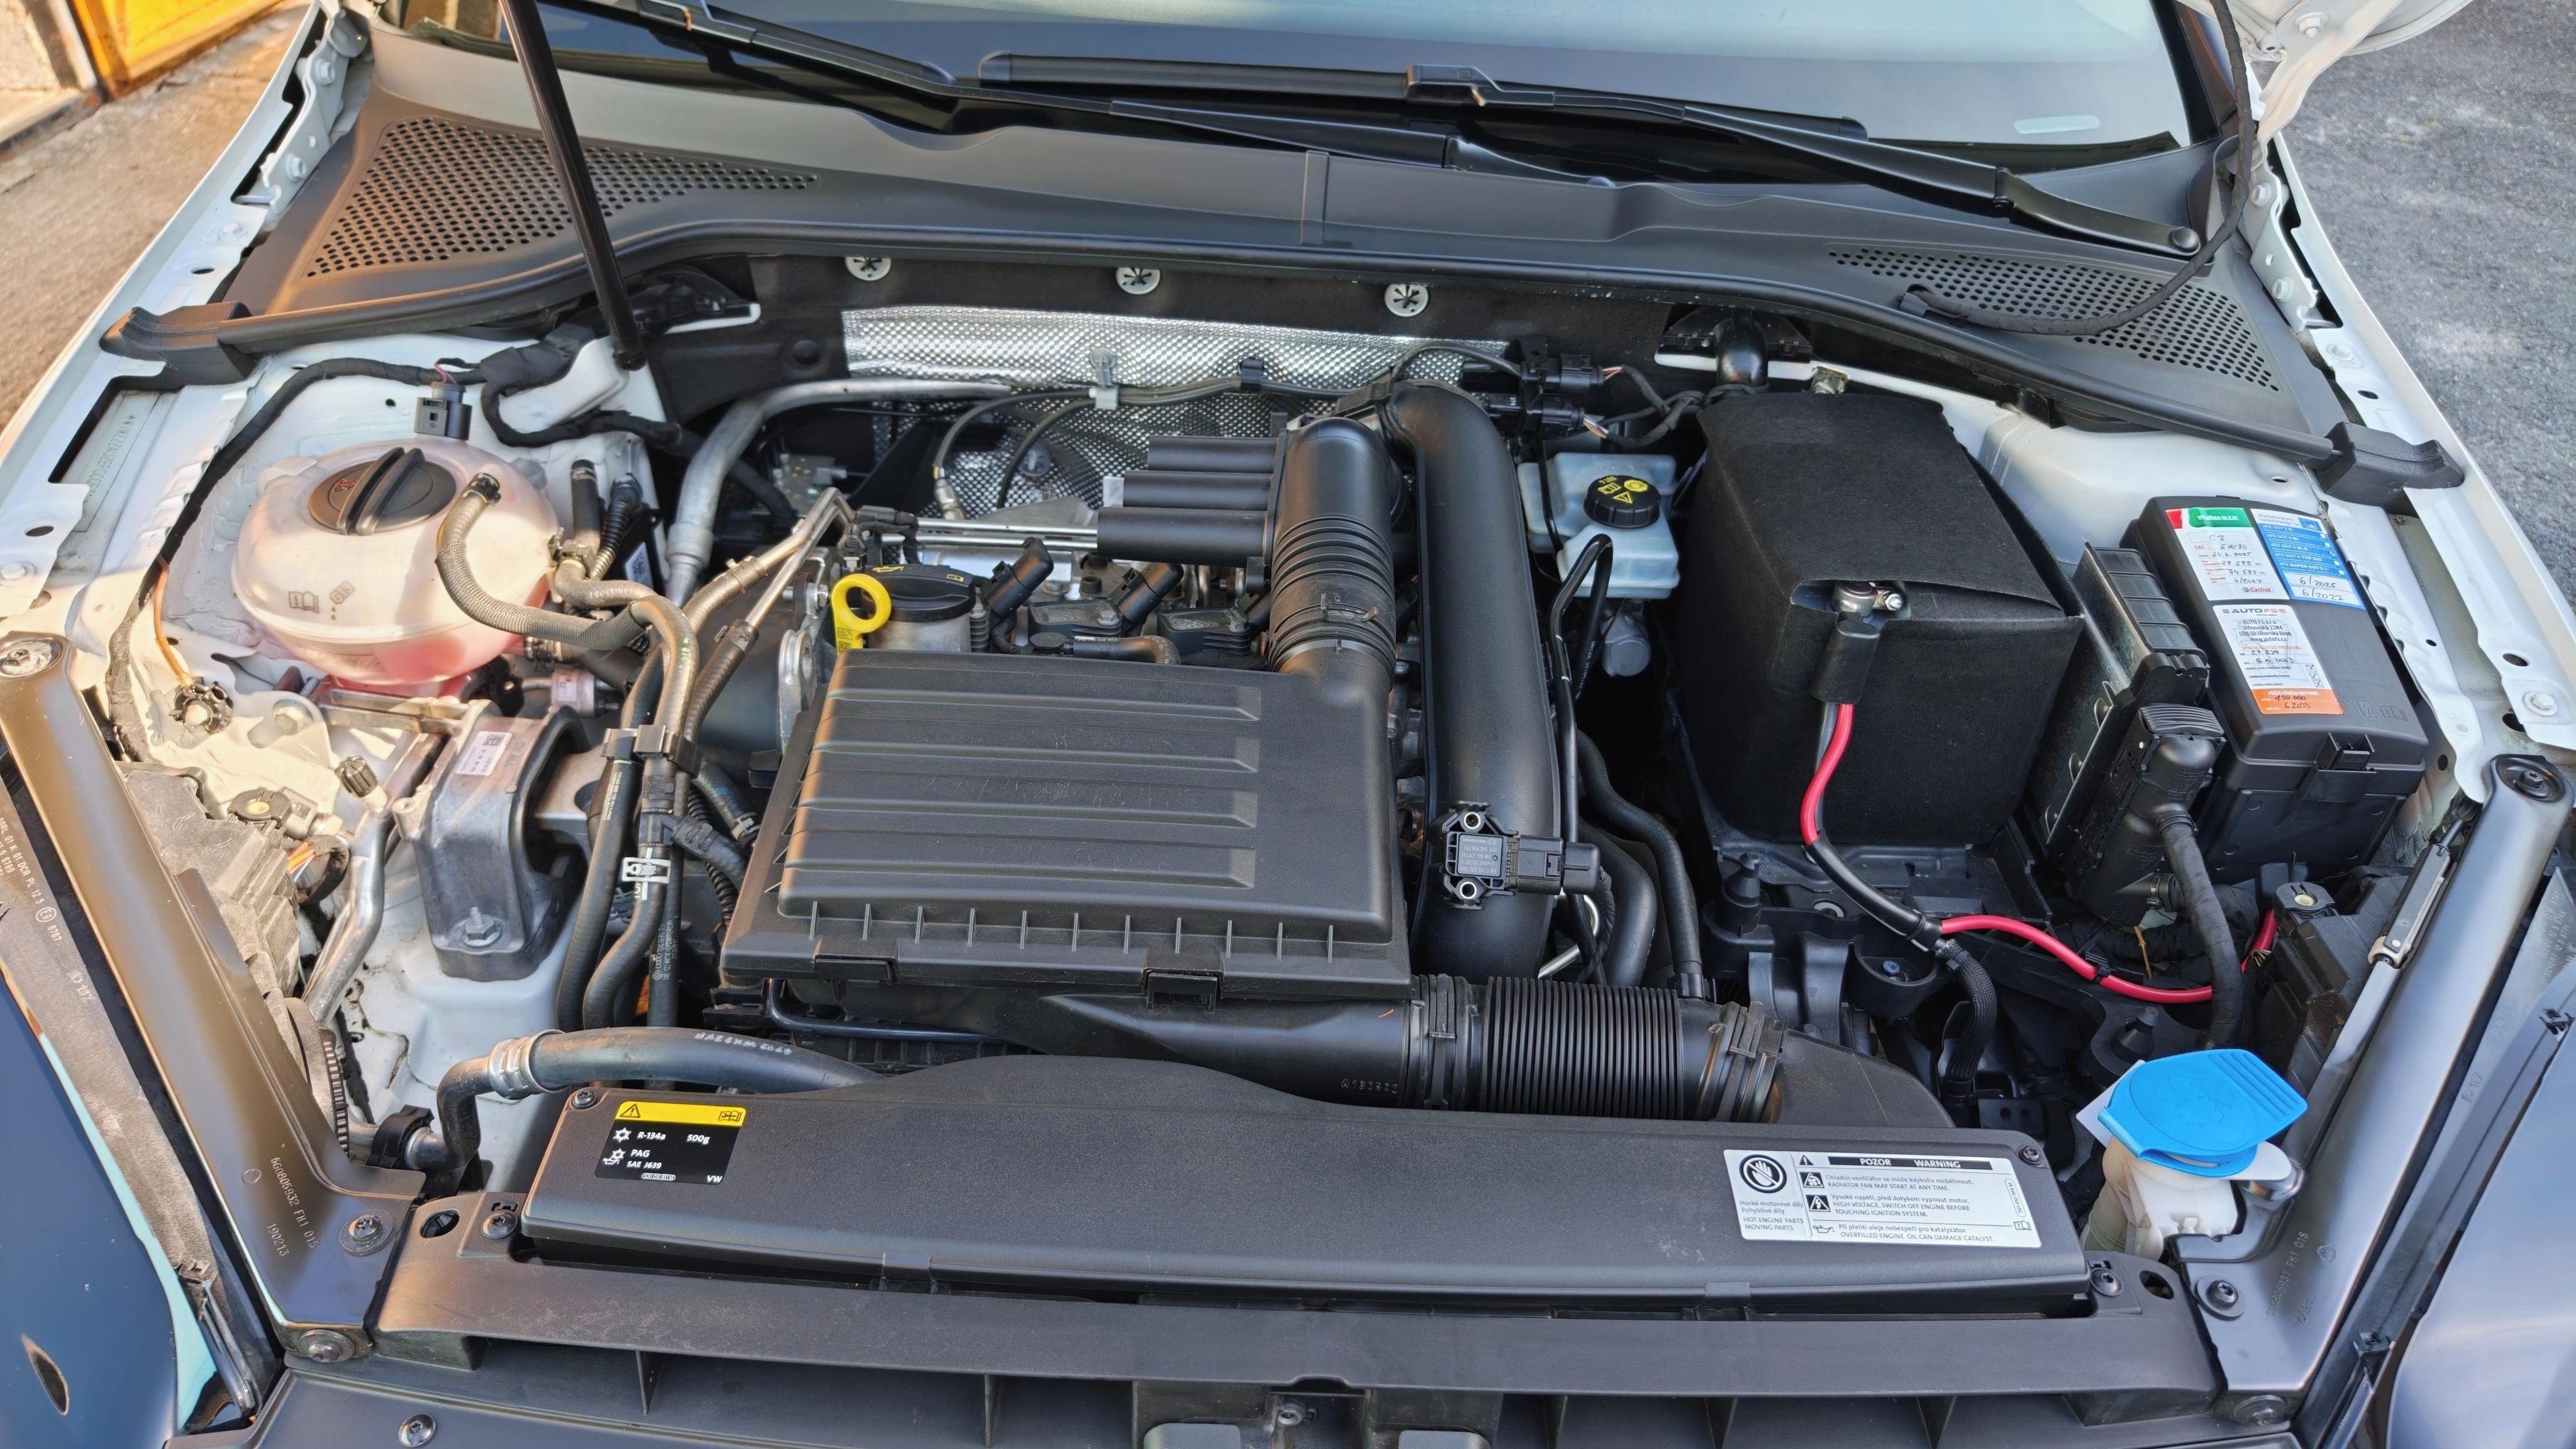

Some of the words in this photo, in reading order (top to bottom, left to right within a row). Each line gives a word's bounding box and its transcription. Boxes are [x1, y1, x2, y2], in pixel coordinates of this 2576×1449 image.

[18, 862, 31, 877] DCR
[26, 877, 36, 889] PL
[637, 1131, 666, 1140] R-134a
[686, 1134, 710, 1145] 500g
[630, 1149, 650, 1157] PAG
[1860, 1158, 1892, 1166] POZOR
[1914, 1160, 1961, 1168] WARNING
[270, 1157, 300, 1206] 5G0805932
[293, 1209, 309, 1227] FH1
[267, 1223, 290, 1257] 190213
